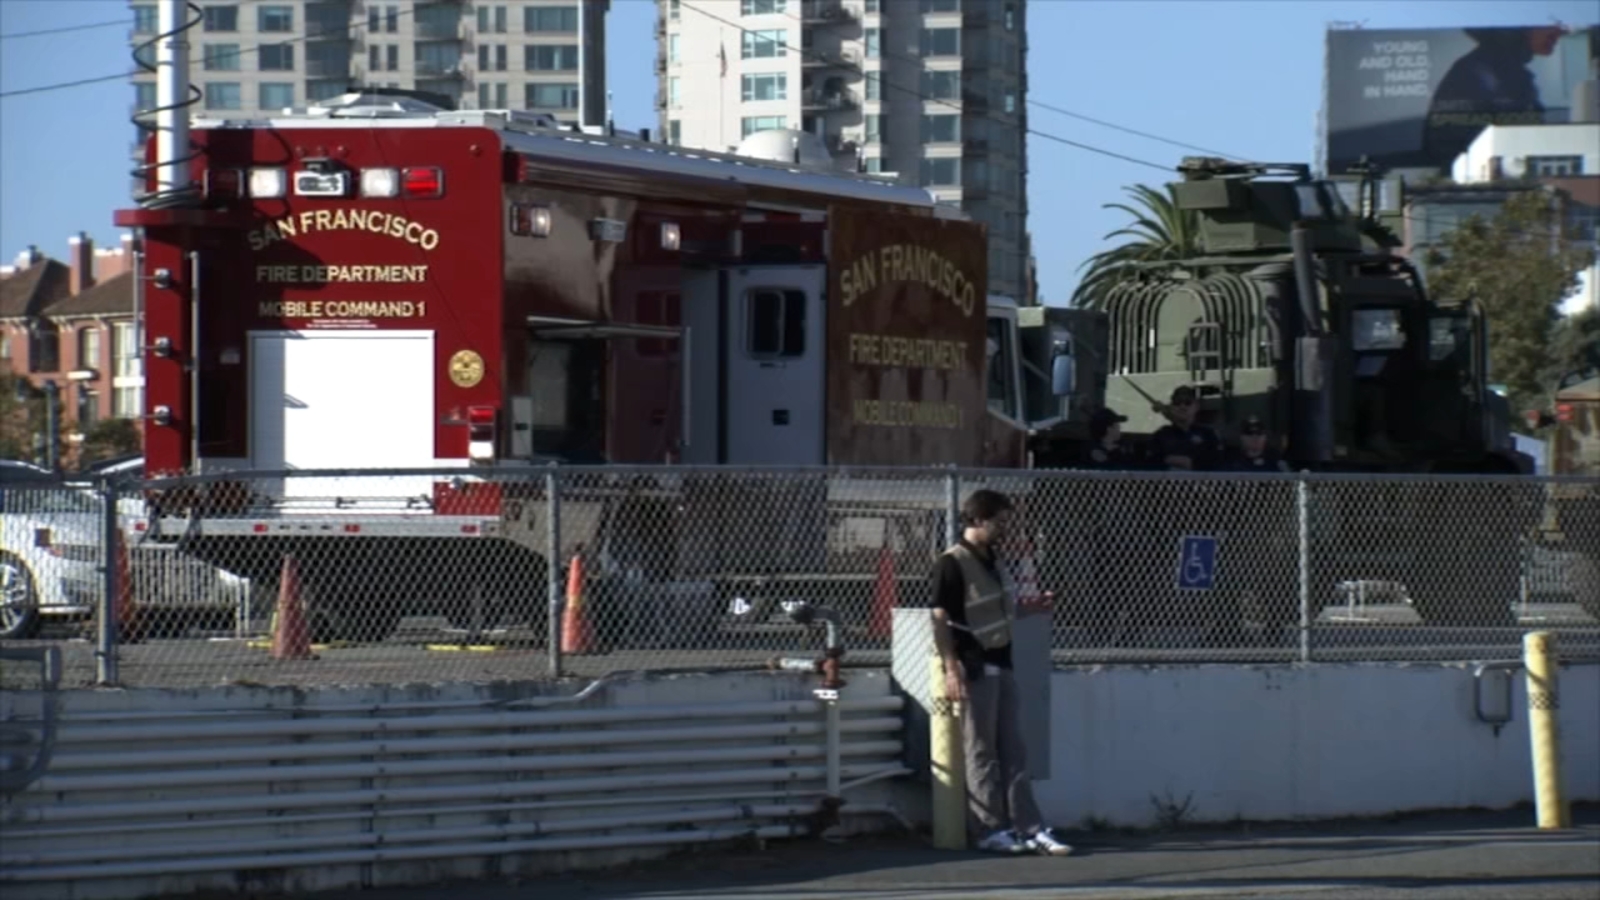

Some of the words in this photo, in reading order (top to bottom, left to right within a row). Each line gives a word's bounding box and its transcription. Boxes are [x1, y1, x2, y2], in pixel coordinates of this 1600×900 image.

[1373, 40, 1428, 54] YOUNG
[1358, 56, 1392, 70] AND
[1384, 69, 1429, 82] HAND
[1363, 85, 1381, 98] IN
[248, 216, 296, 250] SAN
[300, 209, 439, 250] FRANCISCO
[257, 266, 298, 282] FIRE
[303, 265, 427, 282] DEPARTMENT
[841, 252, 876, 307] SAN
[881, 245, 974, 317] FRANCISCO
[259, 301, 322, 316] MOBILE
[325, 301, 414, 317] COMMAND
[416, 301, 425, 316] 1
[850, 333, 881, 365] FIRE
[882, 335, 969, 370] DEPARTMENT
[854, 399, 896, 426] MOBILE
[897, 401, 958, 428] COMMAND
